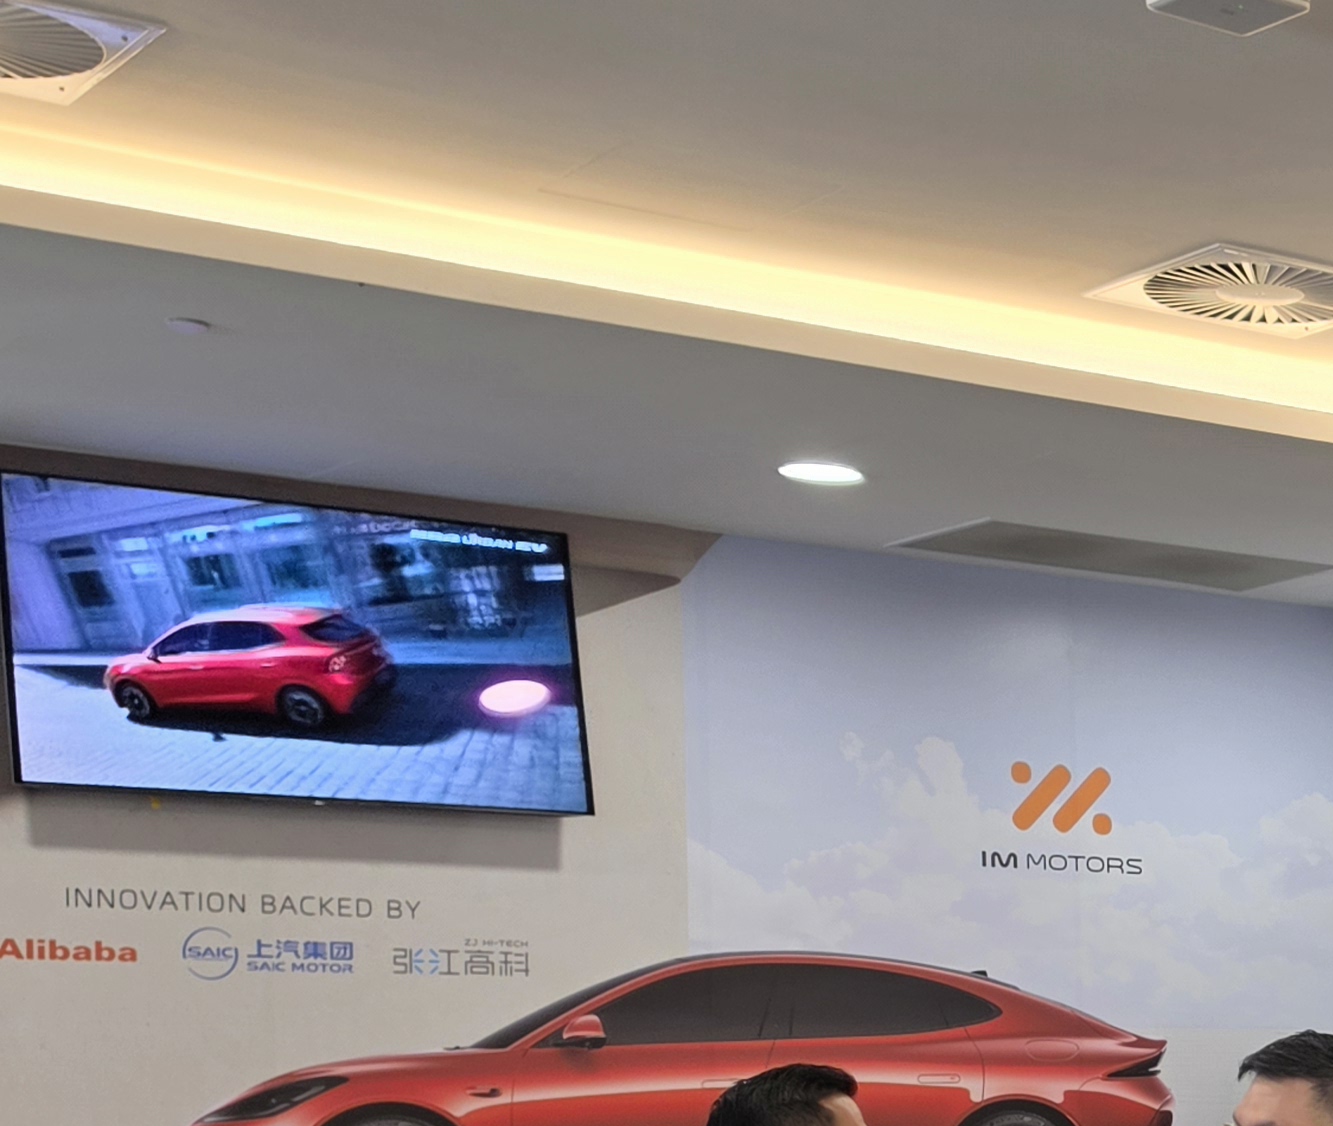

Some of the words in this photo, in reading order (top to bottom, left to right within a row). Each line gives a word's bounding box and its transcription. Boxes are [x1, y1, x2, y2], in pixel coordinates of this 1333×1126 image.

[981, 850, 1018, 869] IM
[1027, 853, 1143, 875] MOTORS
[65, 887, 246, 913] INNOVATION
[260, 894, 373, 918] BACKED
[387, 899, 421, 919] BY
[0, 938, 138, 963] Alibaba
[187, 945, 234, 959] SAIC
[247, 938, 354, 961] 上汽集团
[392, 947, 530, 977] 张江高科
[247, 961, 286, 972] SAIC
[291, 962, 354, 974] MOTOR
